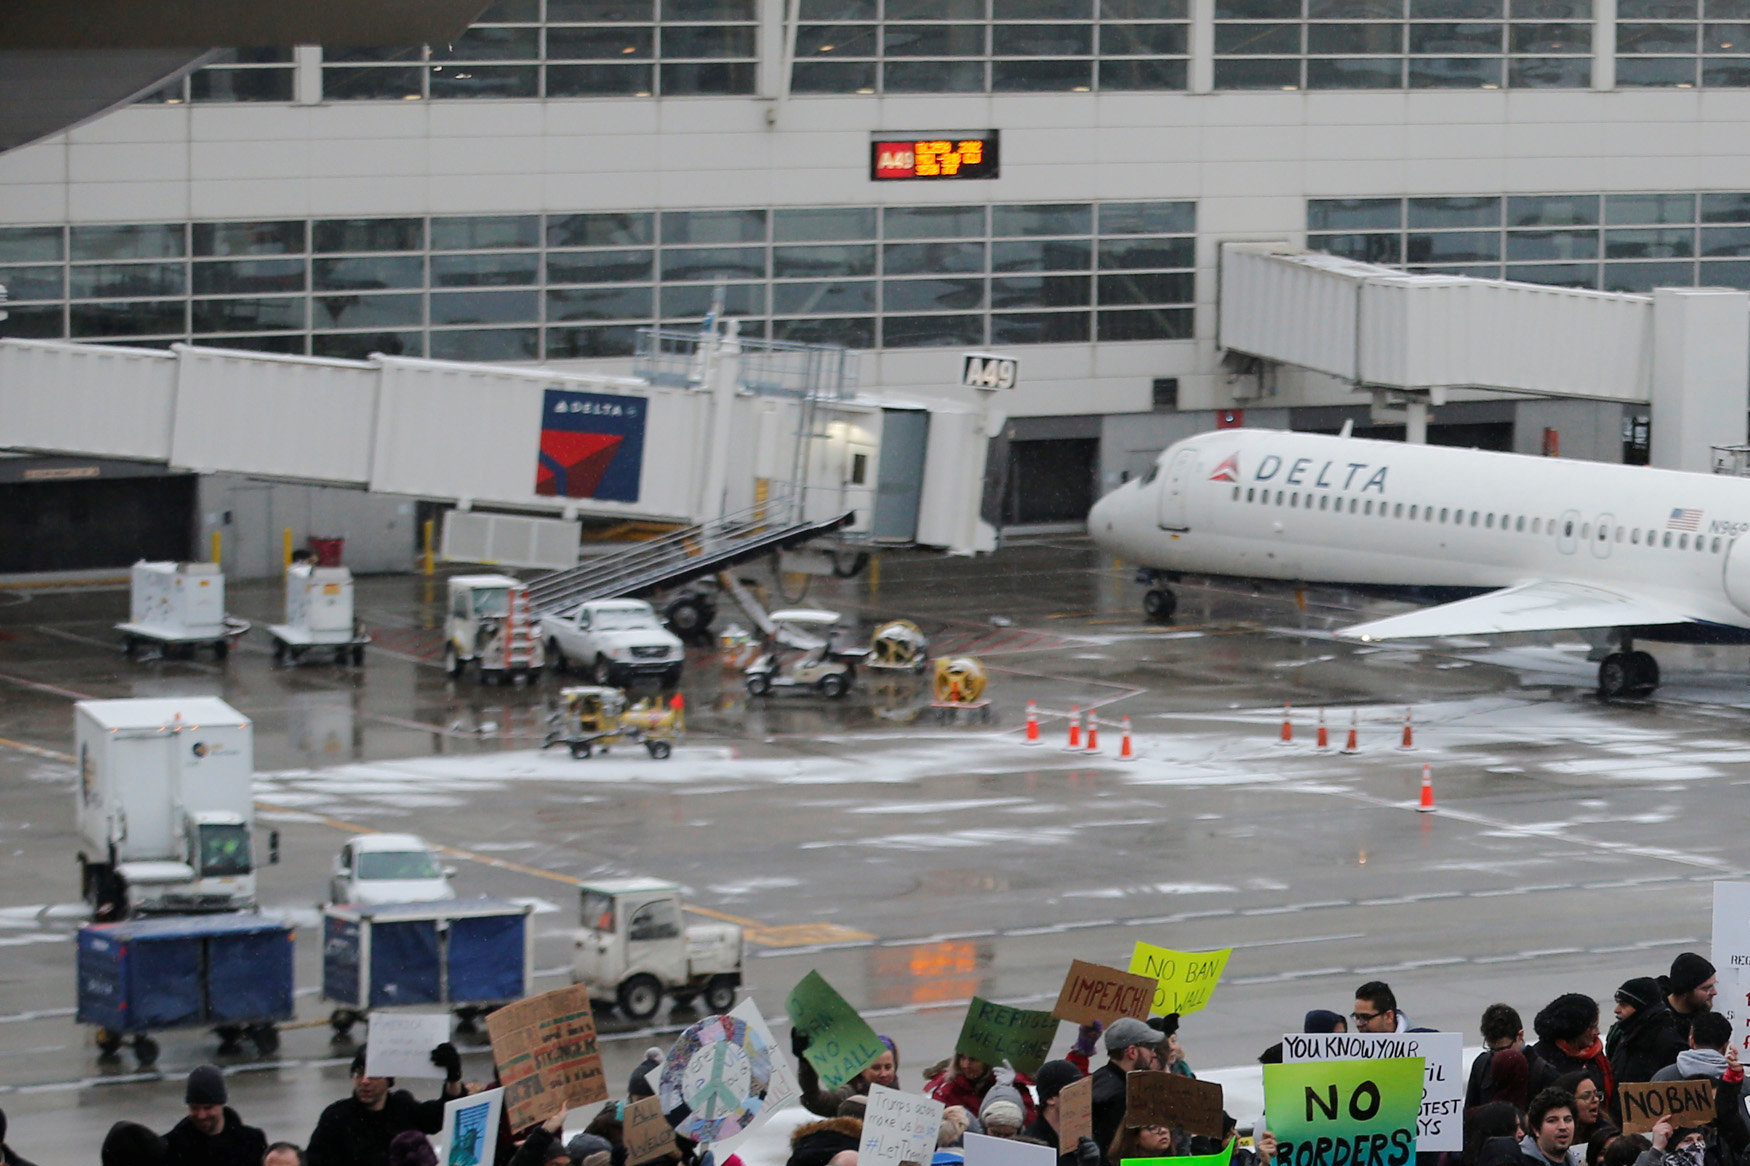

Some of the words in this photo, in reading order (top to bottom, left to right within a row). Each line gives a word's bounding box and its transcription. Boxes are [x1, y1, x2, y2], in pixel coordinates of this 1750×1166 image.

[879, 150, 914, 170] A49
[965, 357, 1016, 388] A49
[571, 400, 625, 417] DELTA
[1254, 454, 1390, 493] DELTA
[1068, 975, 1150, 1019] IMPEACH!
[1305, 1080, 1382, 1123] NO
[1623, 1089, 1663, 1121] NO
[1667, 1084, 1714, 1112] BAN
